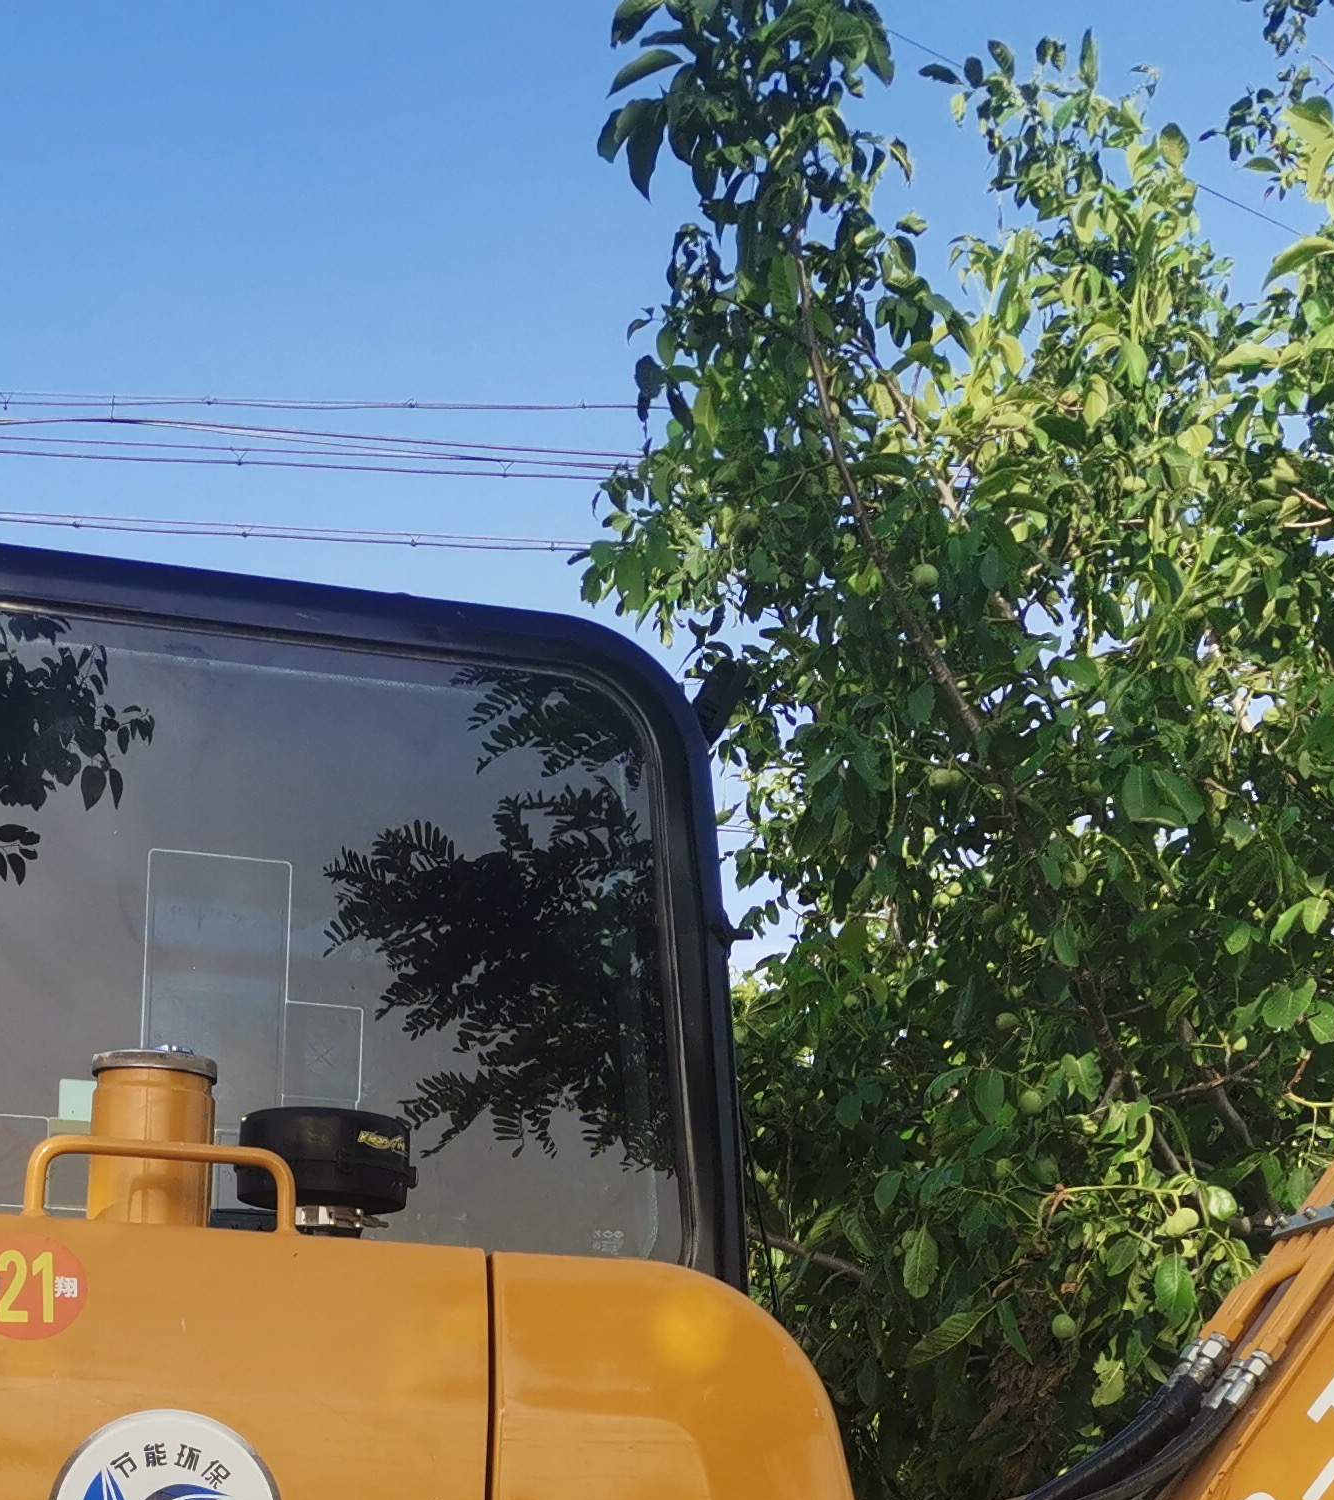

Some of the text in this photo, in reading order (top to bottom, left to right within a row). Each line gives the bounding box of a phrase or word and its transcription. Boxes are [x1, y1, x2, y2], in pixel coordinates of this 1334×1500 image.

[54, 1275, 79, 1299] 翔
[109, 1442, 232, 1490] 节能环保
